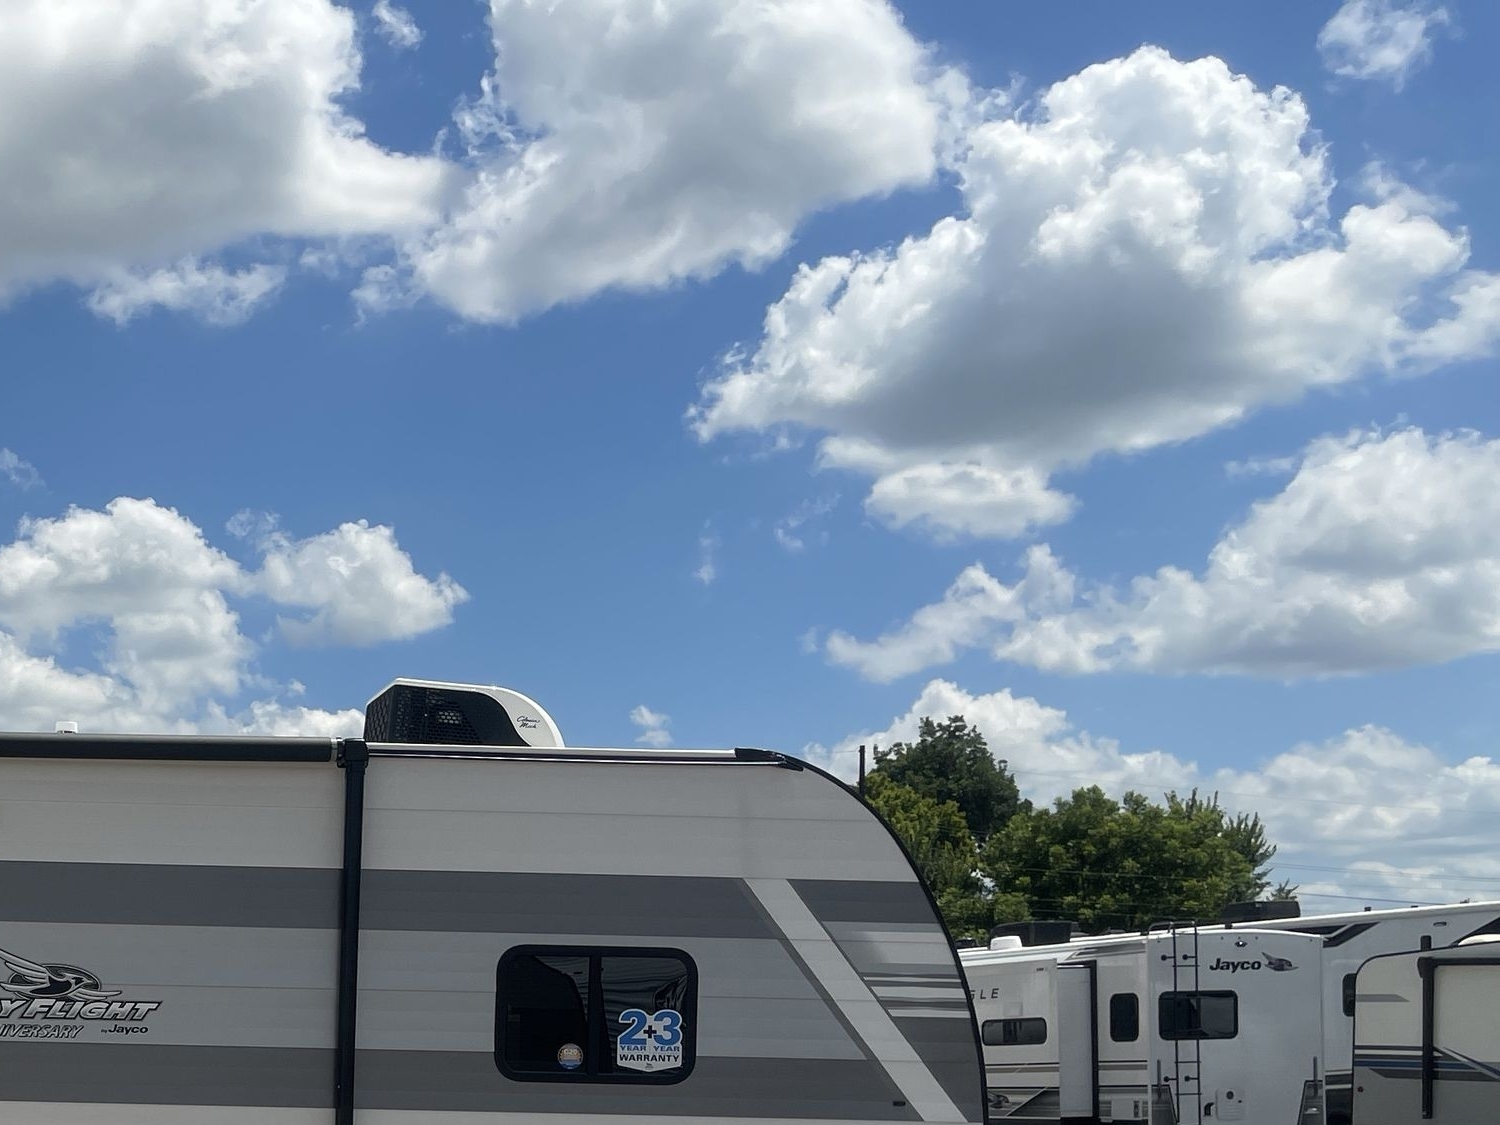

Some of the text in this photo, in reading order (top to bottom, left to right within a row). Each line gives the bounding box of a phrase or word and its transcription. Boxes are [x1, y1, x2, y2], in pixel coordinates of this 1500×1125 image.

[1209, 958, 1262, 973] Jayco
[19, 998, 163, 1021] FLIGHT
[108, 1024, 149, 1035] Jayco
[620, 1054, 680, 1062] WARRANTY
